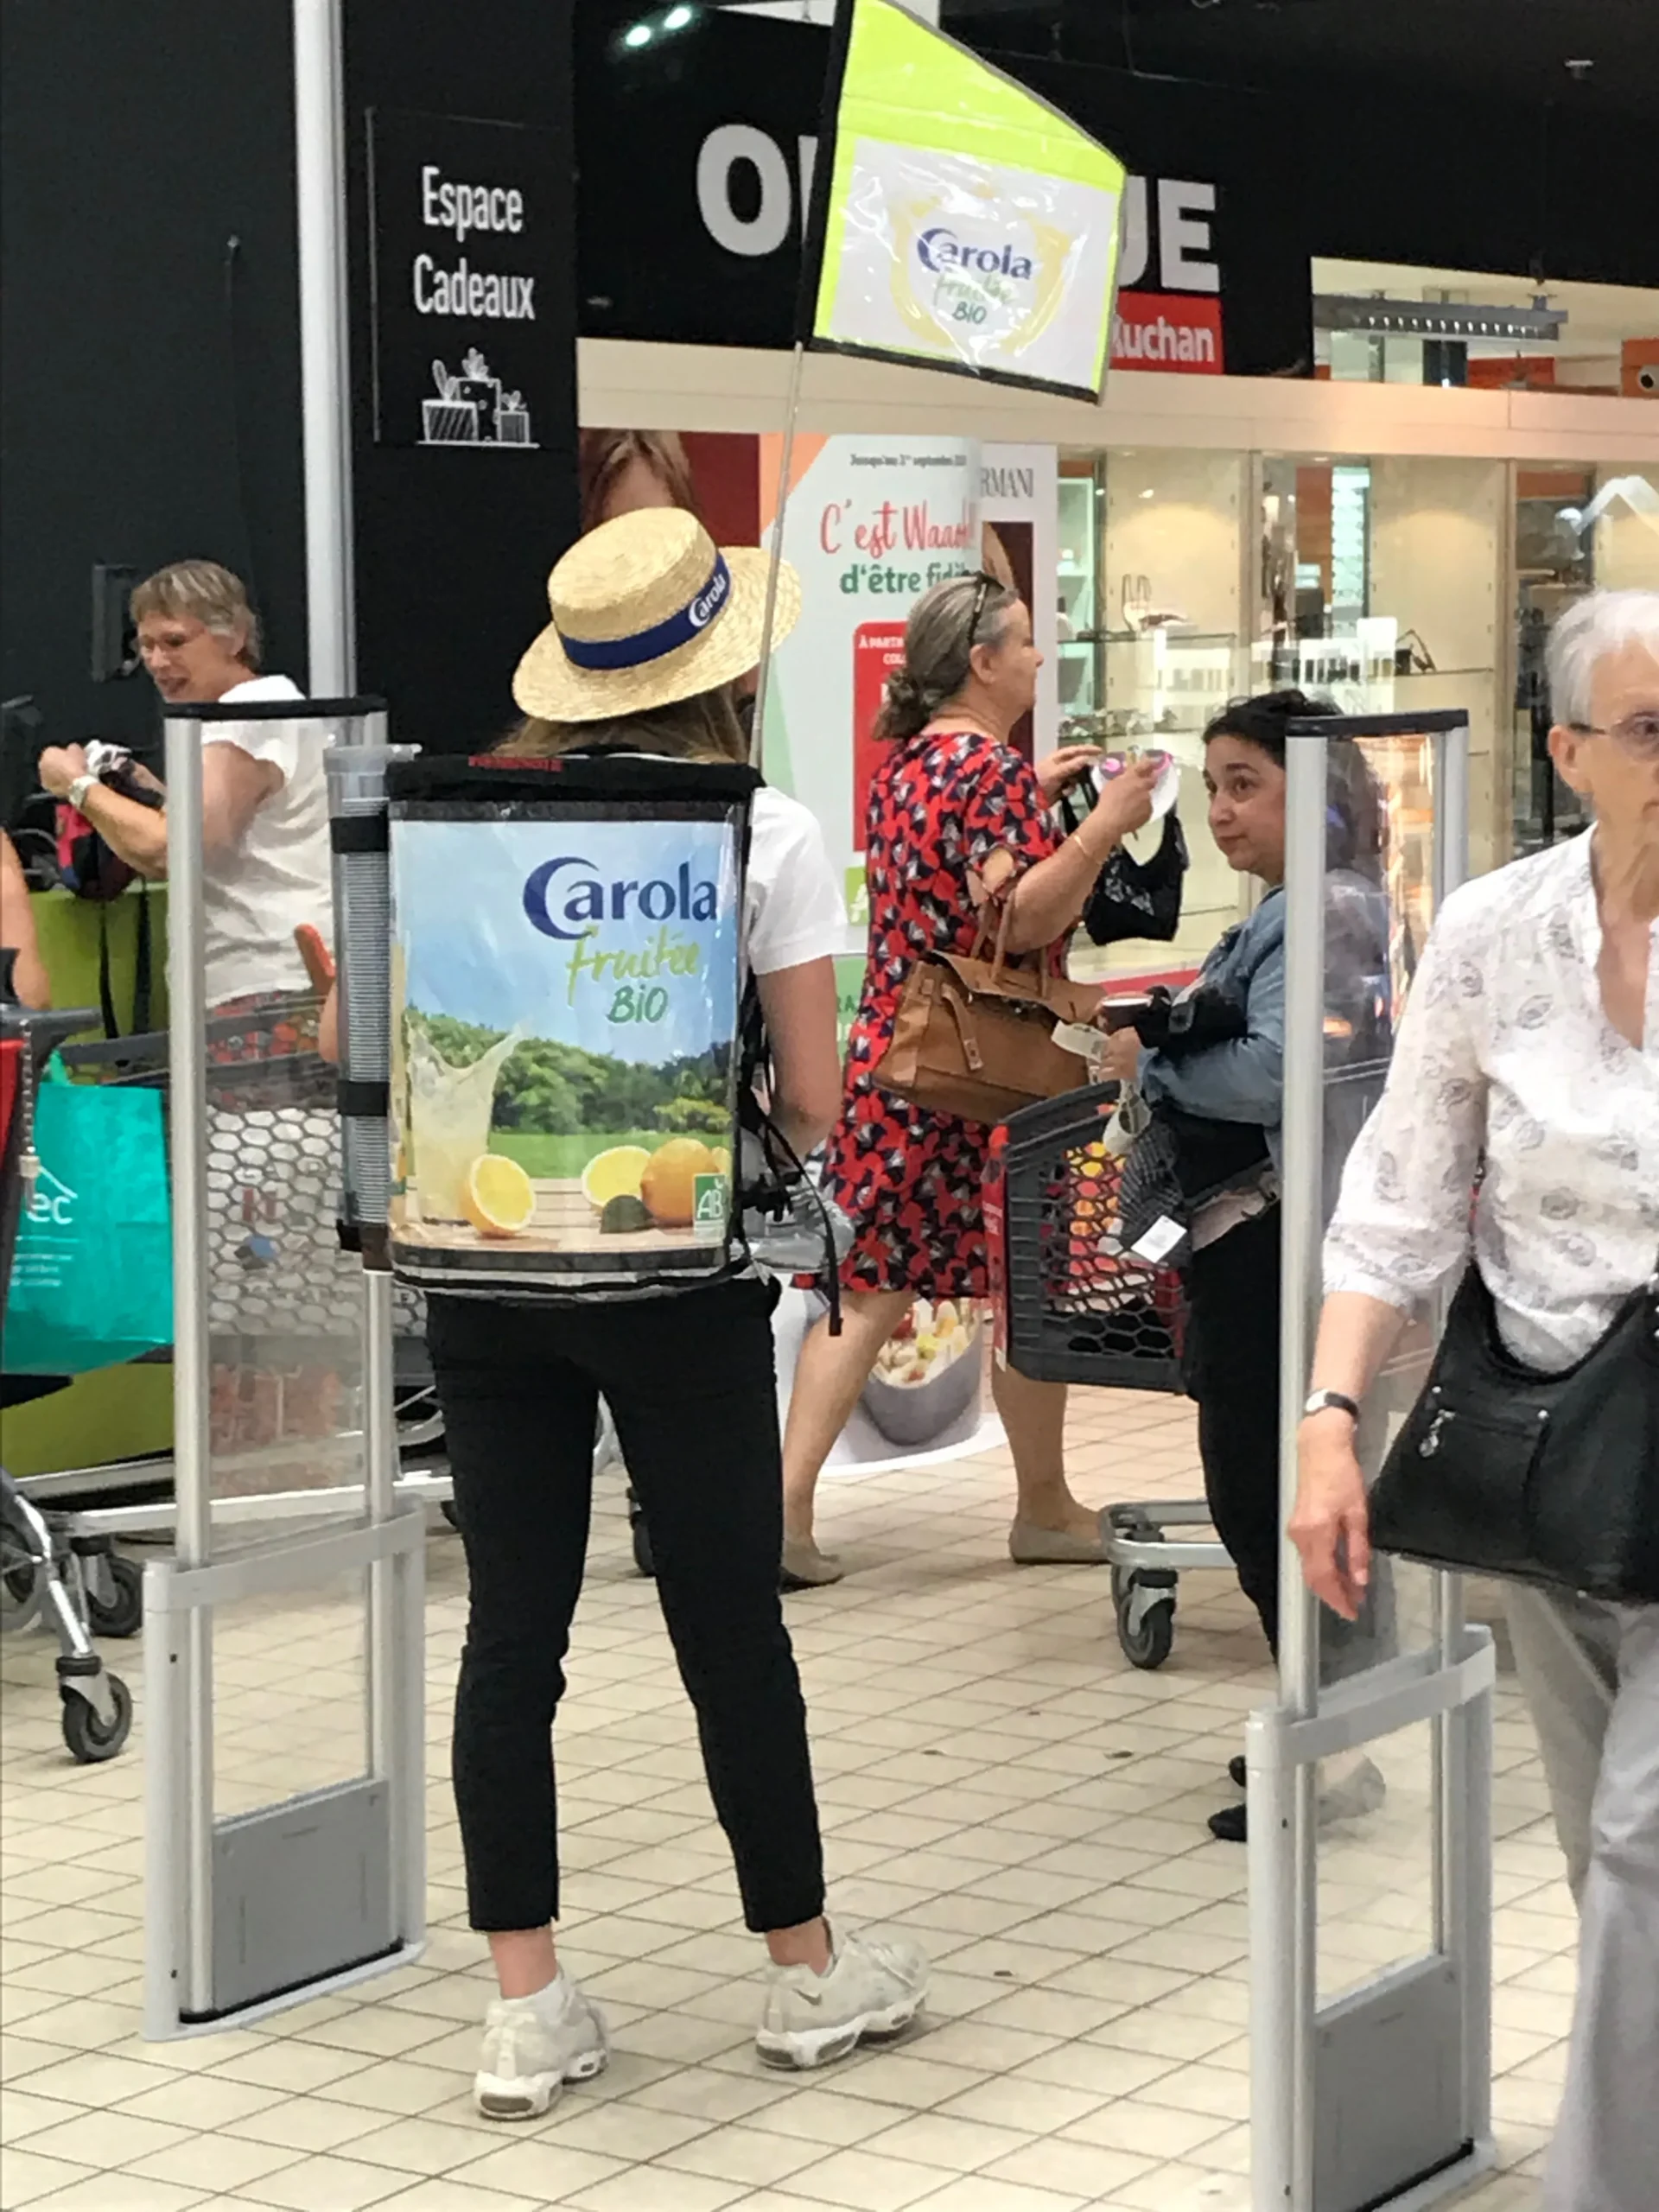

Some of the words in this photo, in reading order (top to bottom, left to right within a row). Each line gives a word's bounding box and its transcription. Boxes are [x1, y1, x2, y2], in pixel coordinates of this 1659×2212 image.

[422, 165, 524, 243] Espace
[917, 227, 1033, 280] Carola
[413, 254, 536, 320] Cadeaux
[980, 467, 1034, 499] RMANI
[820, 498, 899, 559] C'est
[840, 563, 921, 594] d'être
[523, 856, 718, 940] Carola
